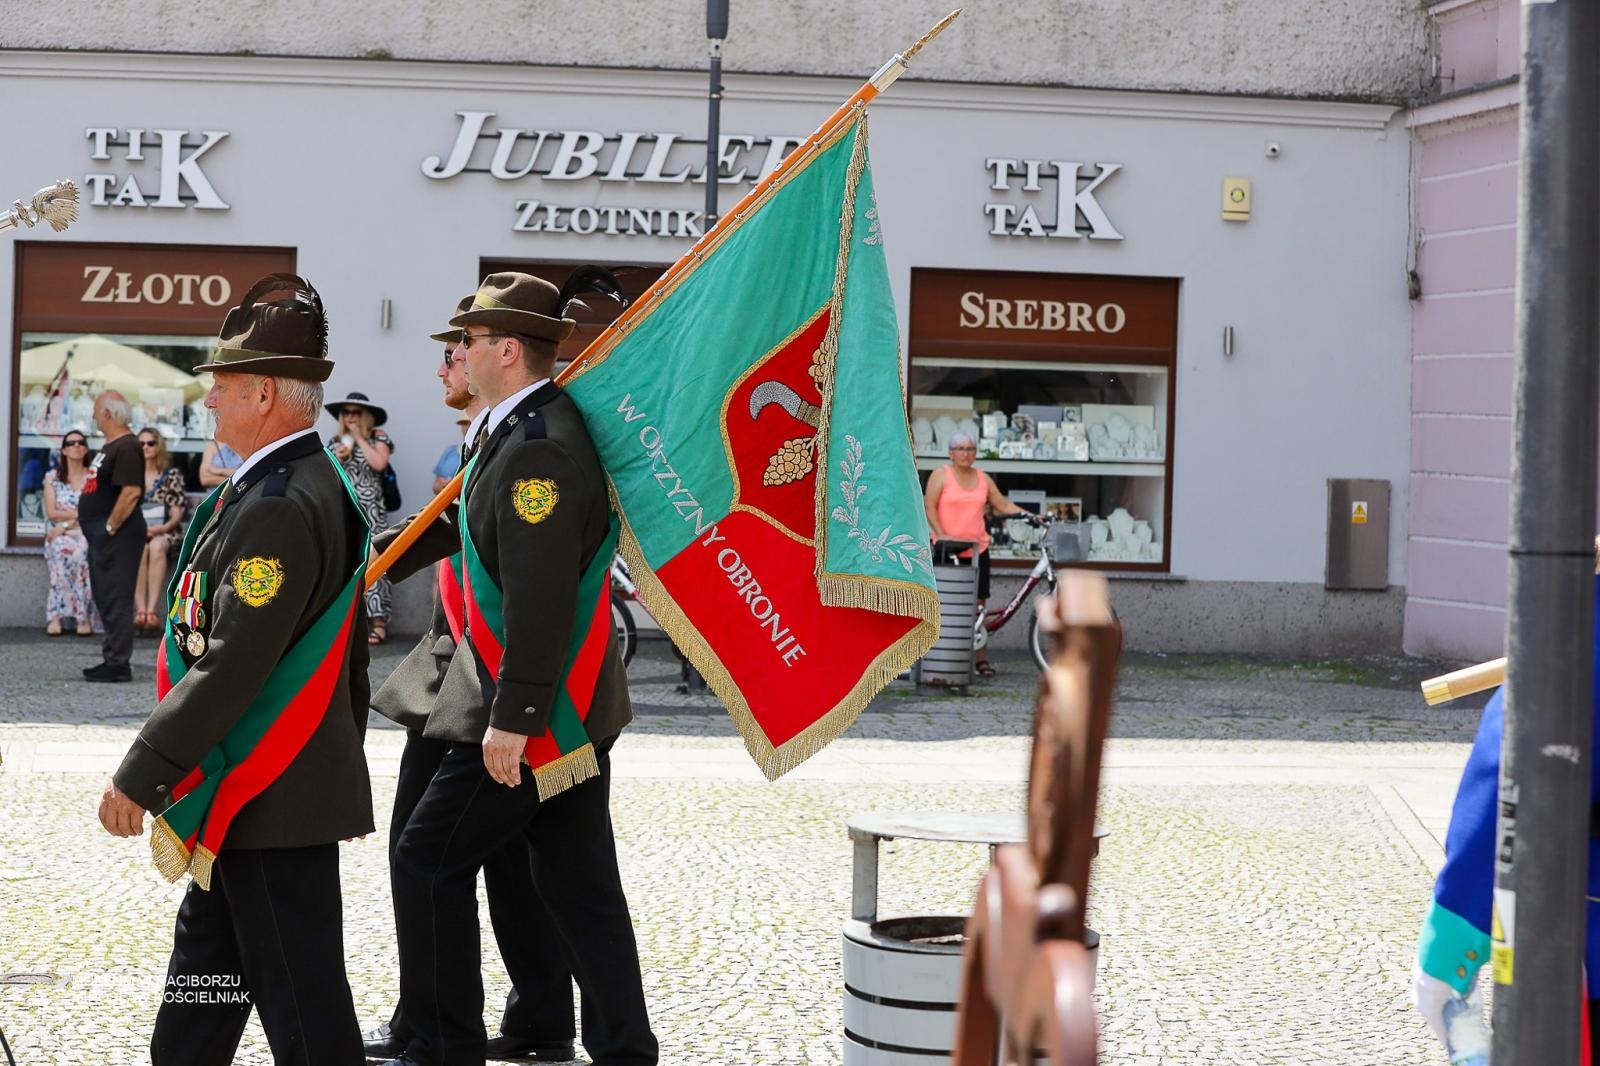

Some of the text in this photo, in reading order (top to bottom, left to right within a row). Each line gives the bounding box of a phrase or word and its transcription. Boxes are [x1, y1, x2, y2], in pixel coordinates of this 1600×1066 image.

[512, 199, 706, 238] ZŁOTNIK
[80, 266, 232, 306] ZŁOTO
[960, 292, 1126, 334] SREBRO
[615, 393, 646, 424] W
[716, 547, 807, 668] OBRONIE
